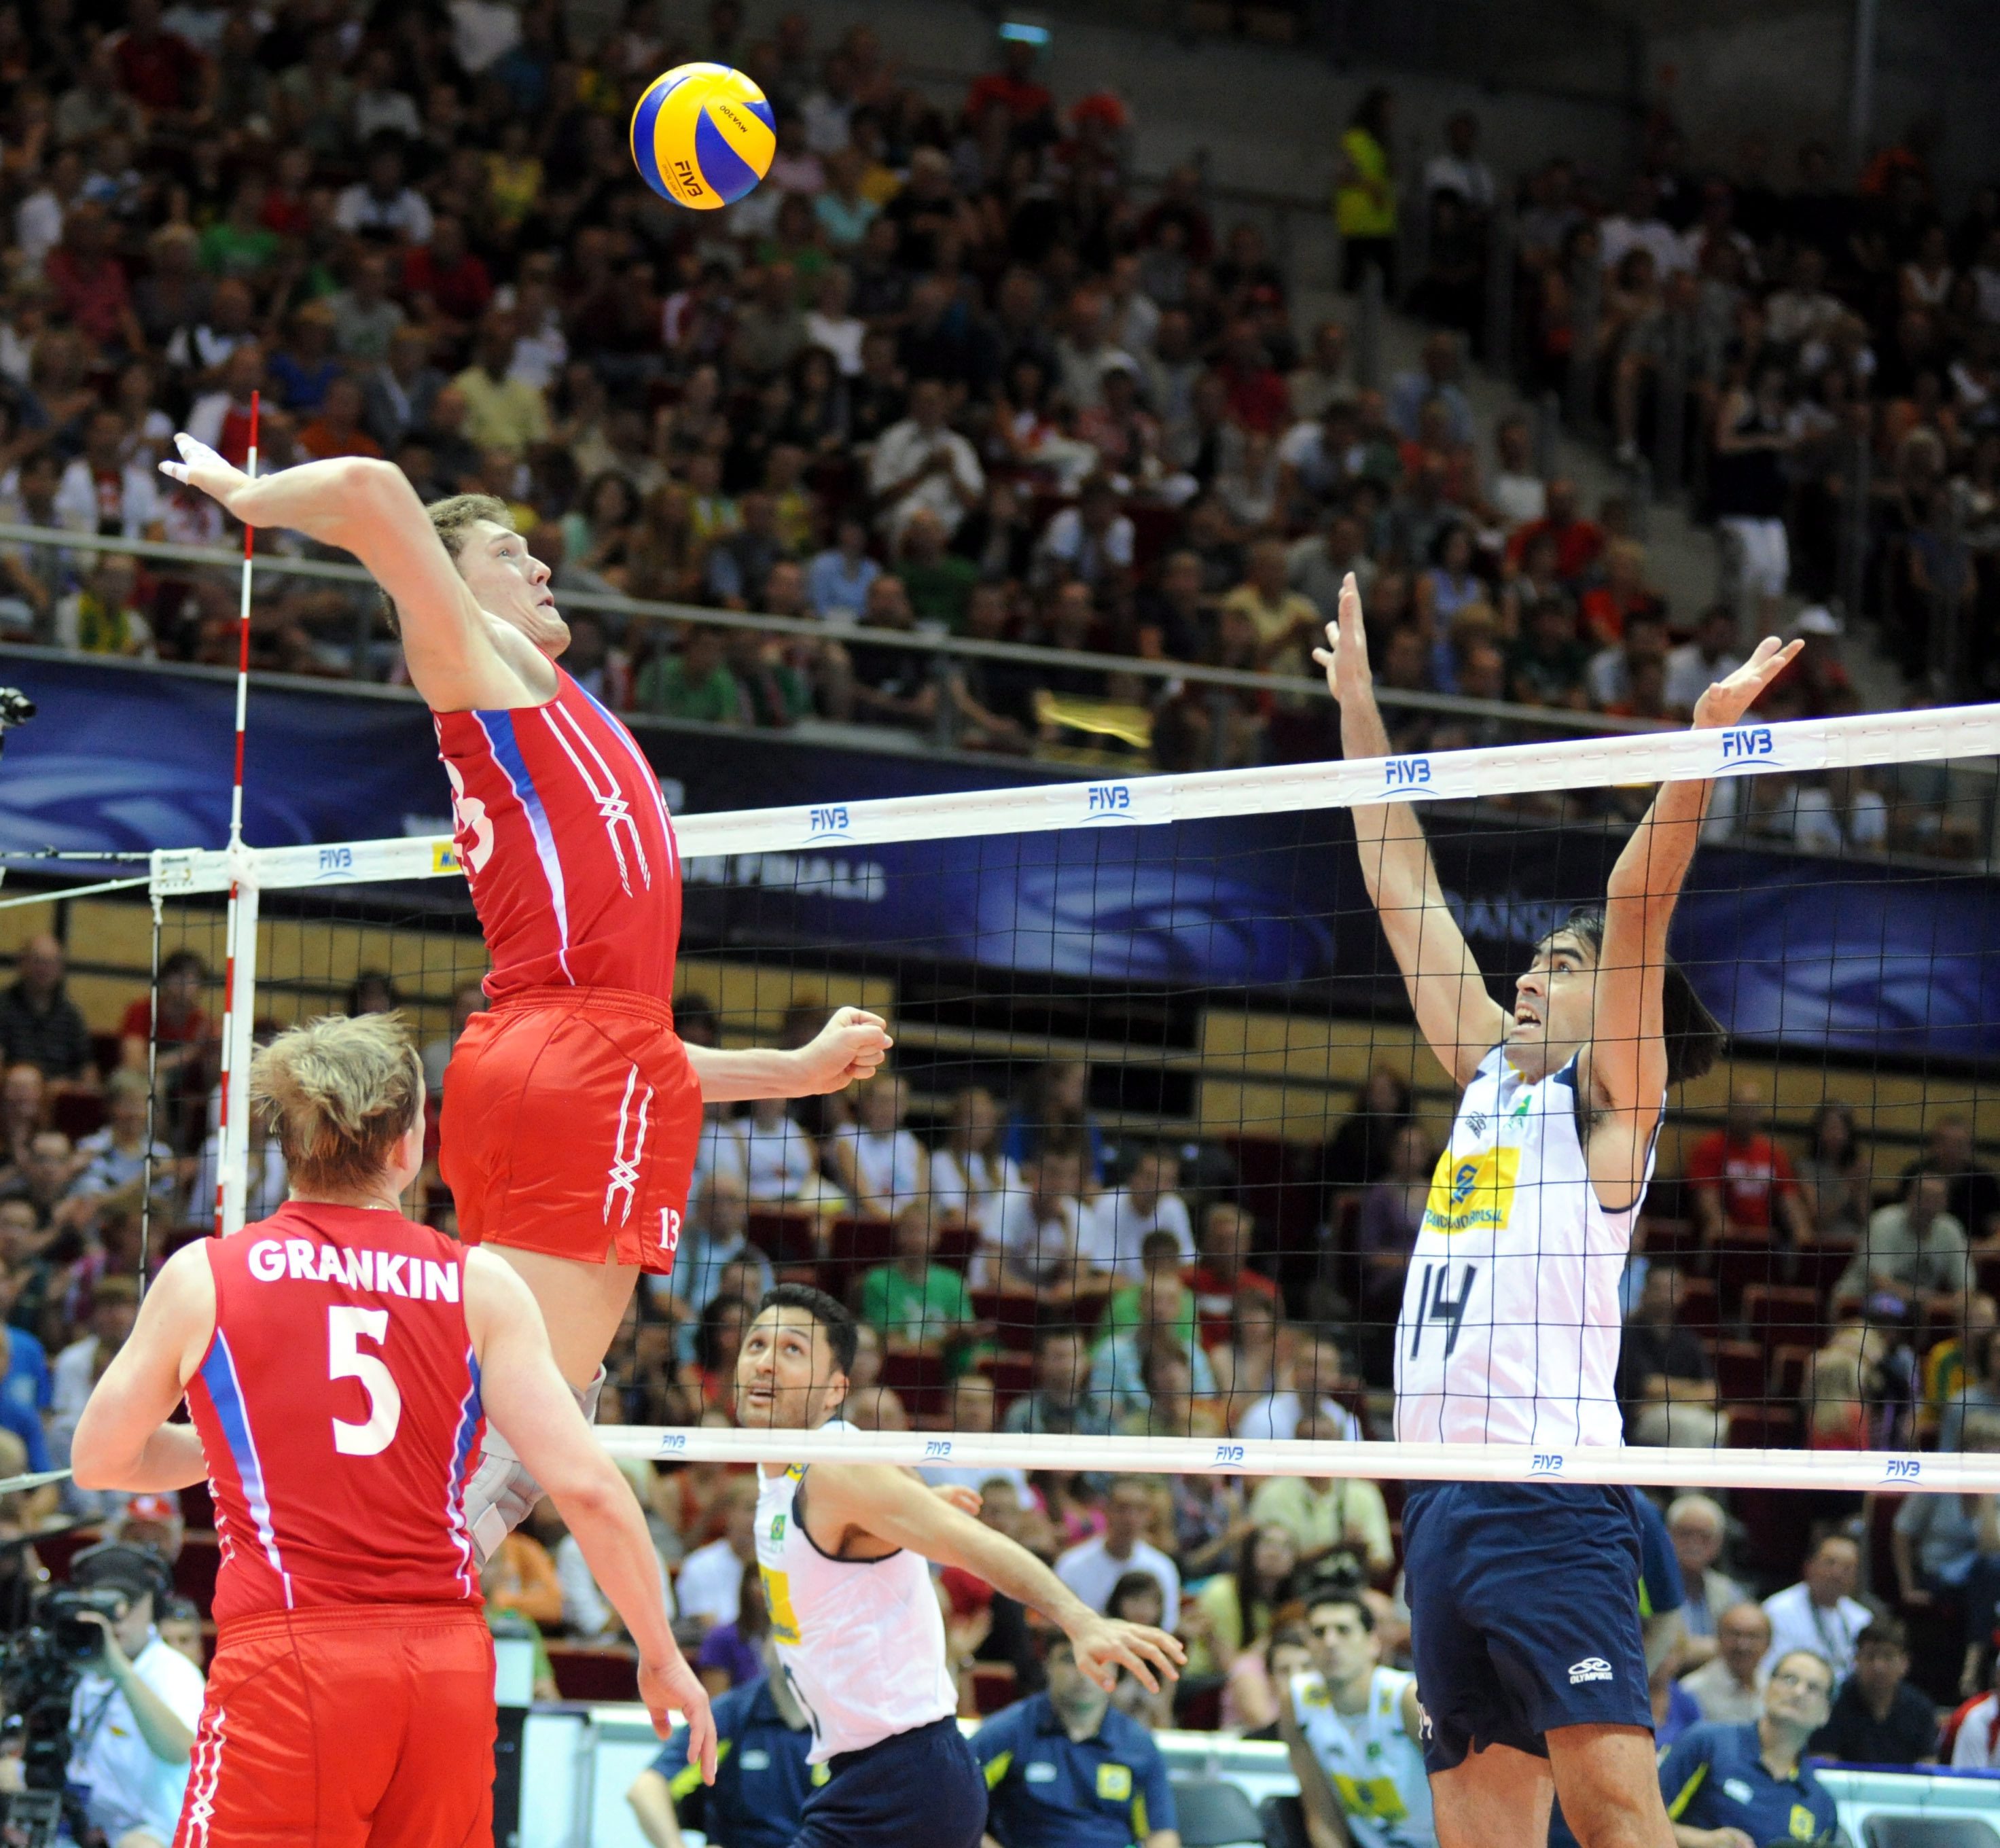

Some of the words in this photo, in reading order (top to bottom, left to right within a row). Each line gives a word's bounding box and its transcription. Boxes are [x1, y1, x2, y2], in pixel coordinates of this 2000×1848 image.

[719, 105, 748, 133] MVA200
[675, 160, 704, 197] FIVB
[1722, 728, 1772, 757] FIVB
[1385, 759, 1431, 784] FIVB
[1088, 786, 1130, 809] FIVB
[810, 806, 849, 830] FIVB
[319, 848, 353, 870] FIVB
[659, 1207, 680, 1251] 13
[248, 1239, 459, 1302] GRANKIN
[1410, 1264, 1478, 1361] 14
[328, 1304, 401, 1455] 5
[662, 1434, 685, 1449] FIVB
[925, 1442, 951, 1455] FIVB
[1216, 1446, 1244, 1460] FIVB
[1531, 1455, 1563, 1469] FIVB
[1886, 1460, 1920, 1476] FIVB
